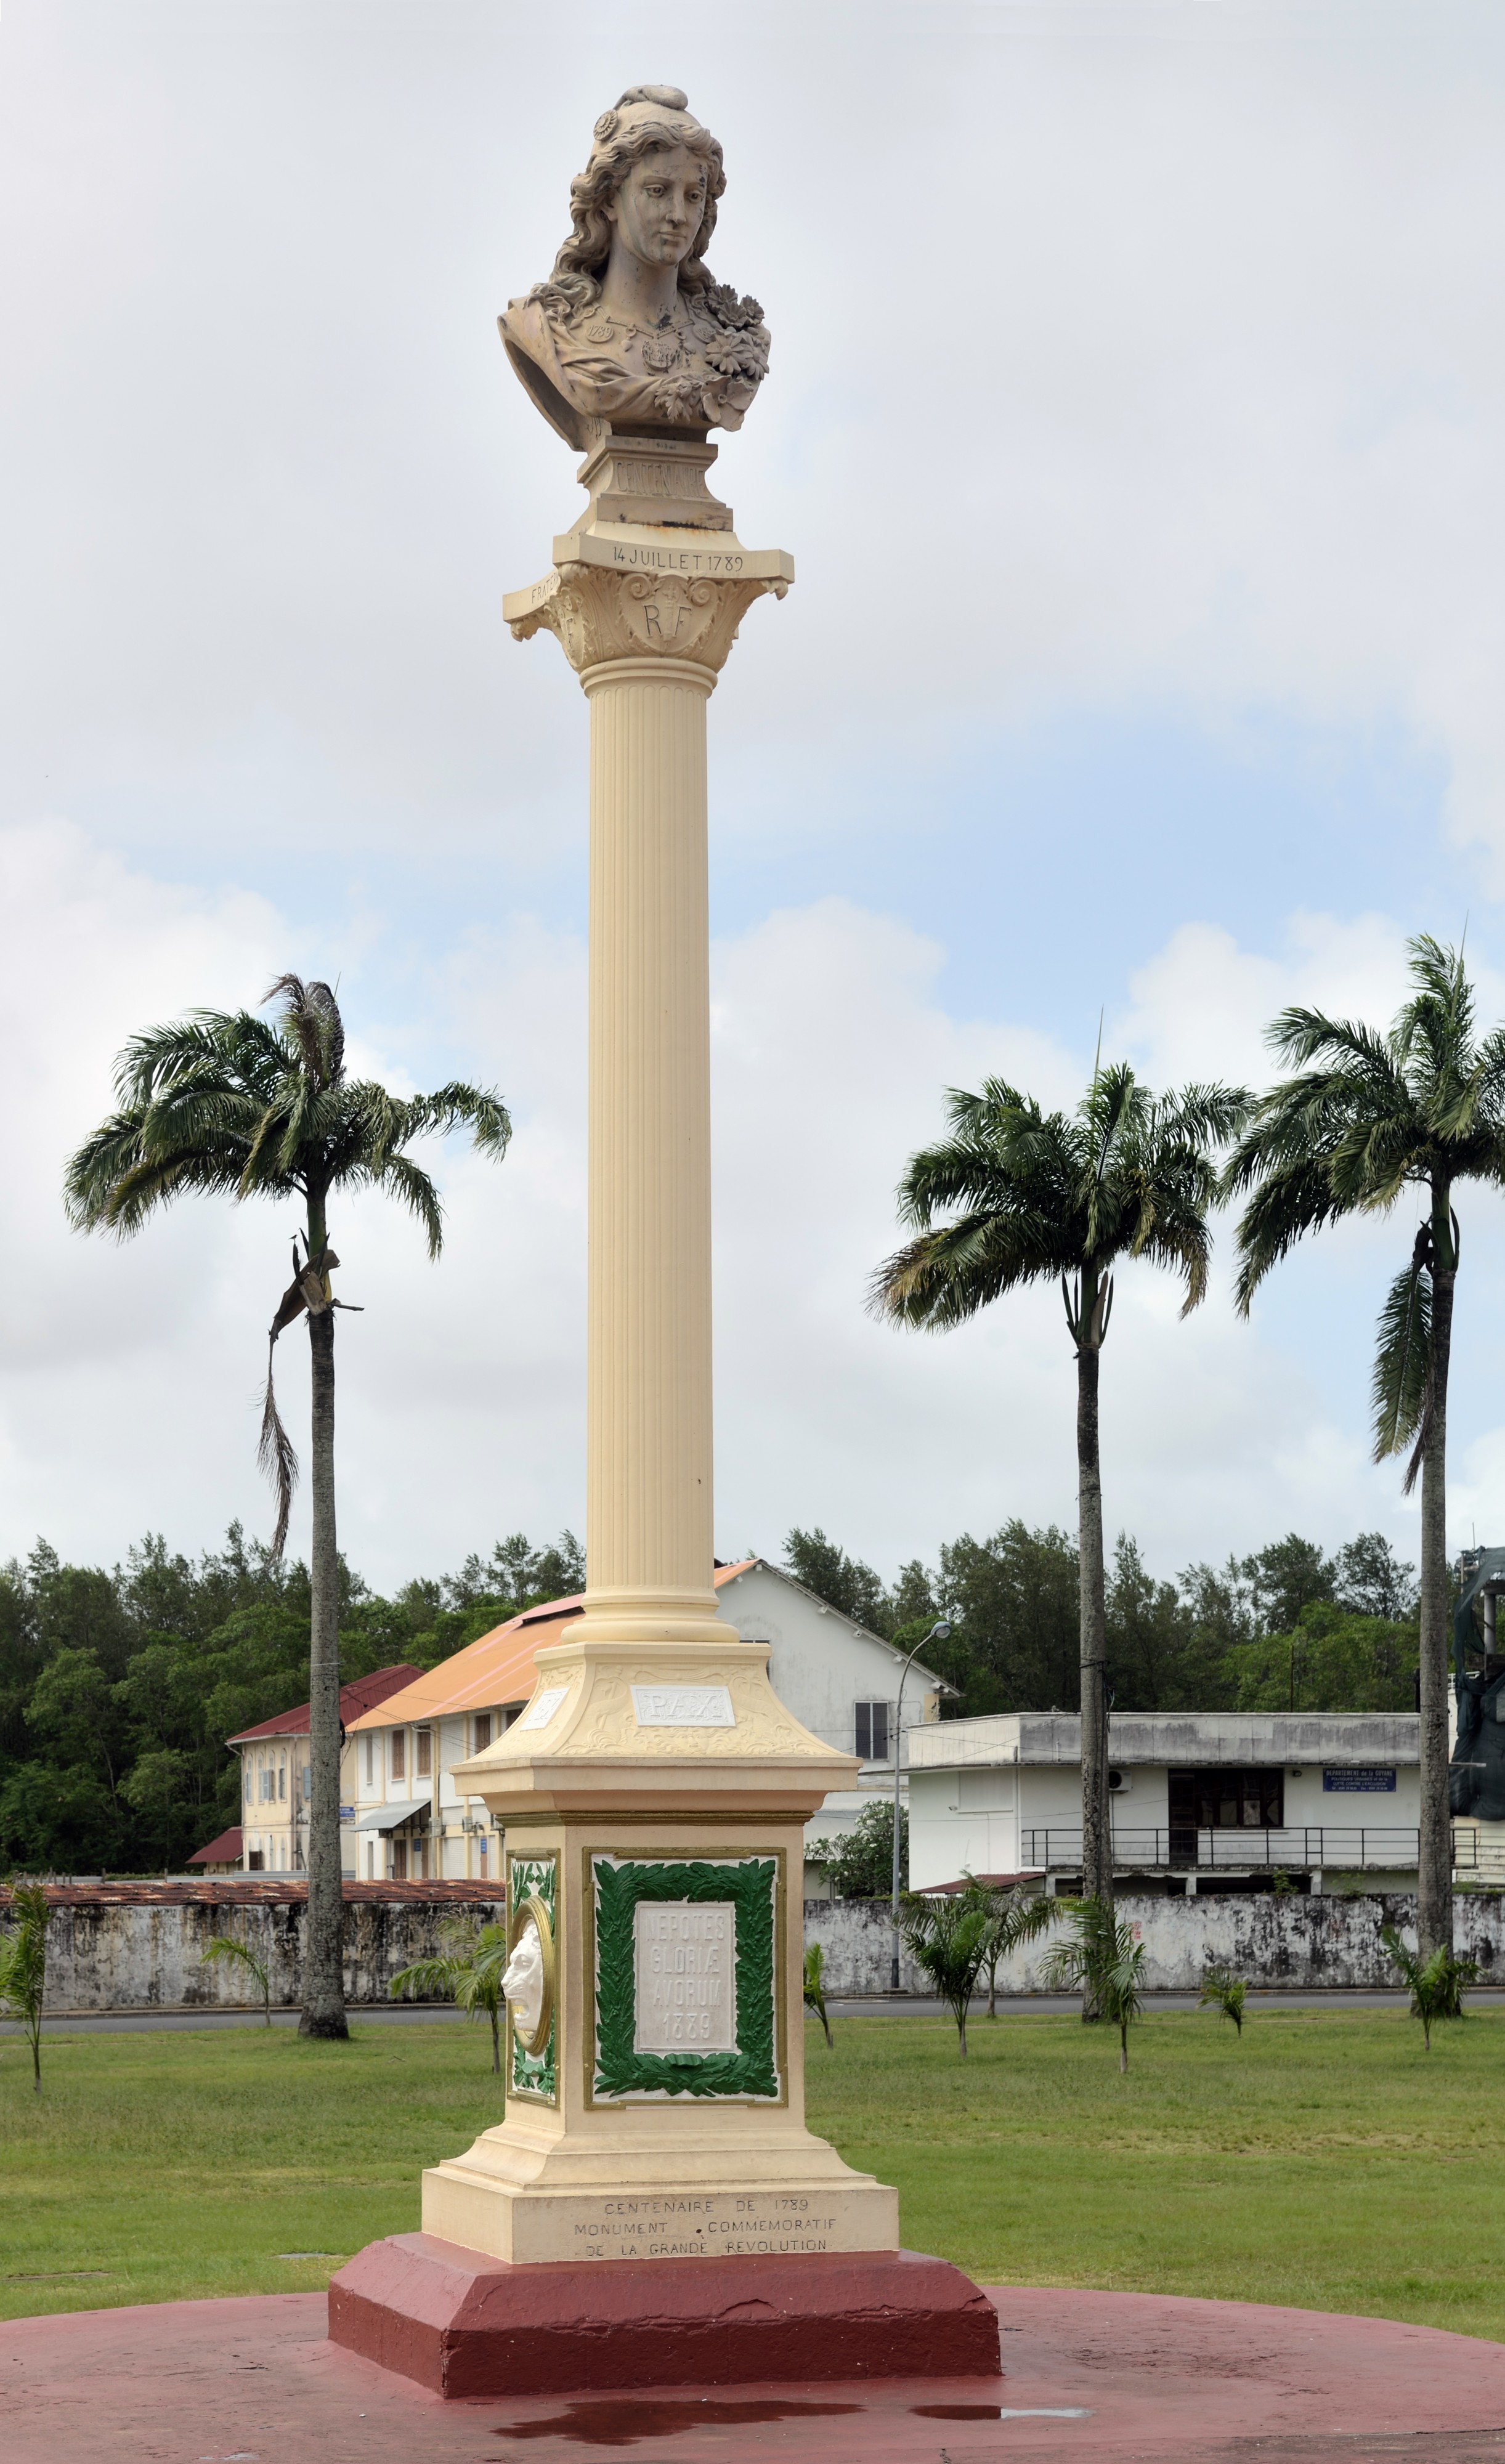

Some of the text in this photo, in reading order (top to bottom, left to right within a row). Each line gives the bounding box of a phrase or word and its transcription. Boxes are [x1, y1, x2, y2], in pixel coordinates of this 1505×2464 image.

[588, 325, 612, 338] 1789
[617, 463, 708, 498] CENTENAIRE
[614, 546, 743, 572] 14 JUILLET 1789
[643, 1695, 723, 1717] PAX
[647, 1914, 724, 1940] NEPOTES
[653, 1980, 721, 2007] AVORUM
[663, 2013, 709, 2040] 1889
[604, 2199, 808, 2215] CENTENAIRE DE 1789
[574, 2219, 836, 2235] MONUMENT COMMEMORATIF
[586, 2239, 826, 2256] DE LA GRANDE REVOLUTION
